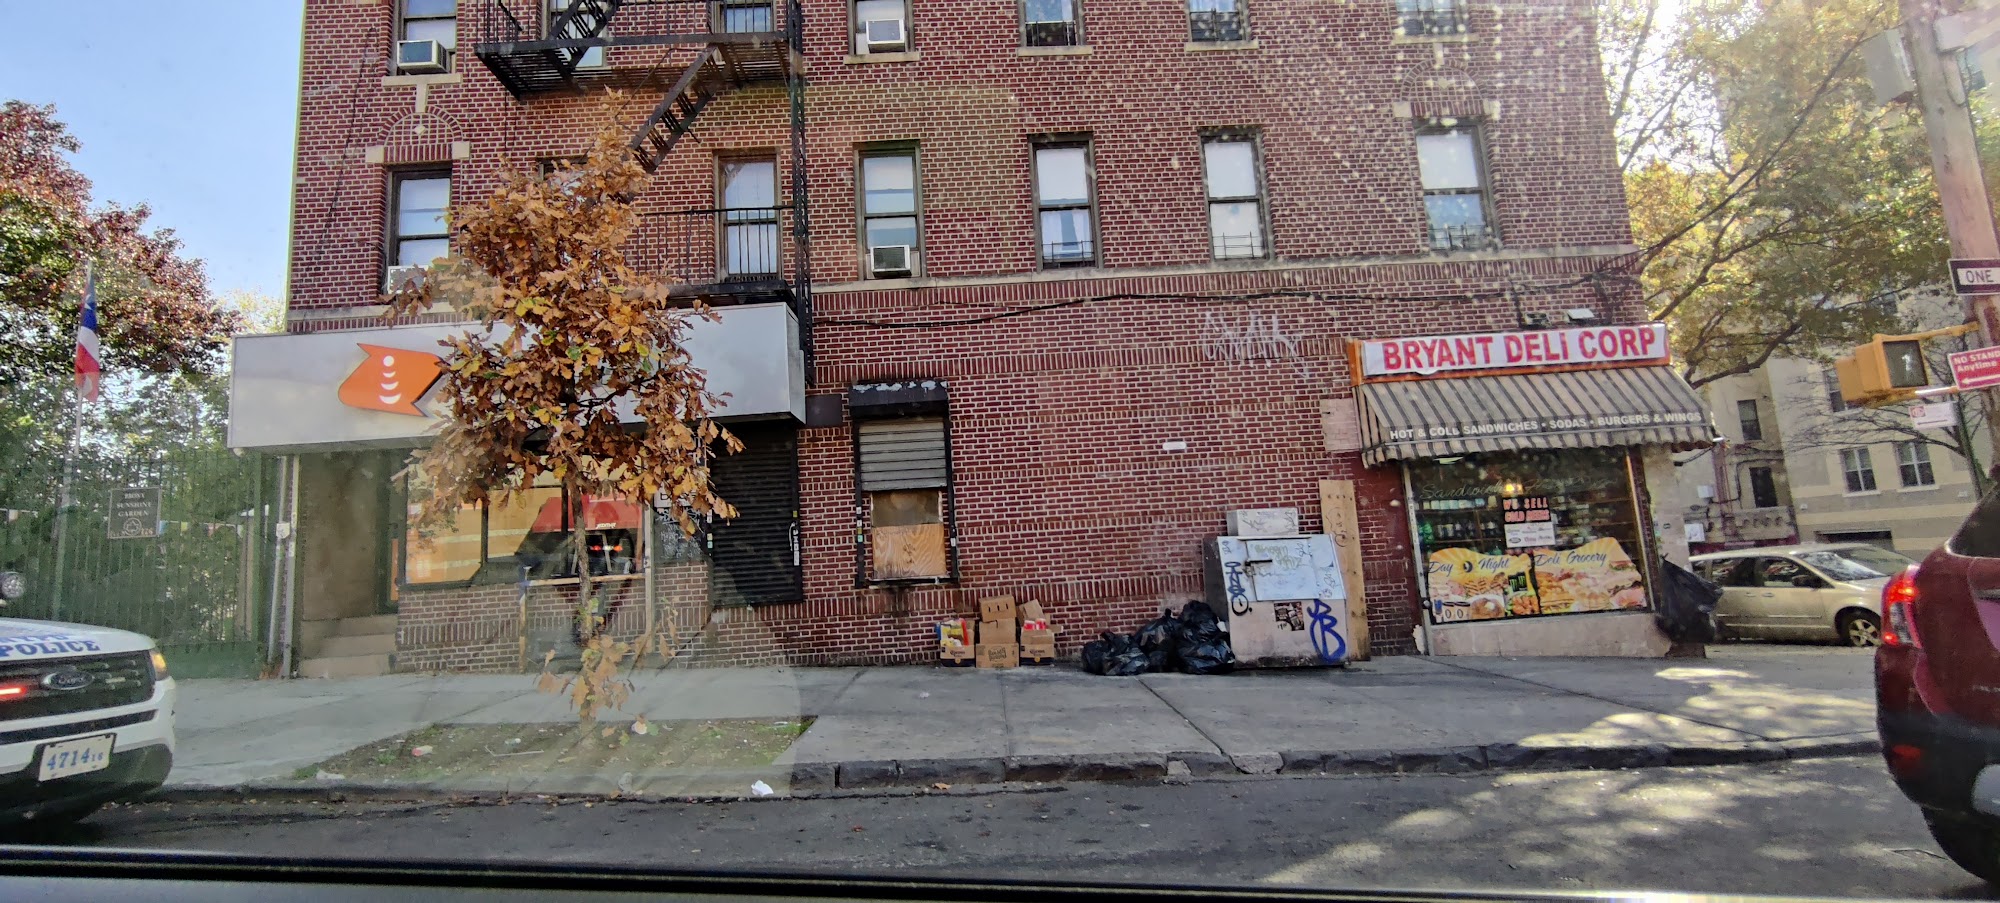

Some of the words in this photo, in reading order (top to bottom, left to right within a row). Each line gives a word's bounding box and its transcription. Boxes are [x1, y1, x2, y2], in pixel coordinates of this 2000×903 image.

[1966, 269, 1994, 283] ONE
[1383, 336, 1493, 371] BRYANT
[1503, 332, 1569, 363] DELI
[1578, 327, 1656, 359] CORP
[1953, 356, 1967, 365] NO
[1957, 360, 1998, 372] Anytime
[1390, 429, 1414, 440] HOT
[1417, 428, 1426, 438] &
[1463, 420, 1539, 435] SANDWICHES
[1549, 417, 1587, 429] SODAS
[1598, 413, 1650, 427] BURGERS
[1653, 413, 1662, 423] &
[1664, 411, 1703, 423] WINGS
[1524, 497, 1548, 509] SELL
[1428, 561, 1453, 577] Day
[1478, 556, 1510, 575] Night
[1534, 552, 1560, 567] Deli
[1566, 550, 1607, 567] Grocery
[0, 640, 100, 657] POLICE
